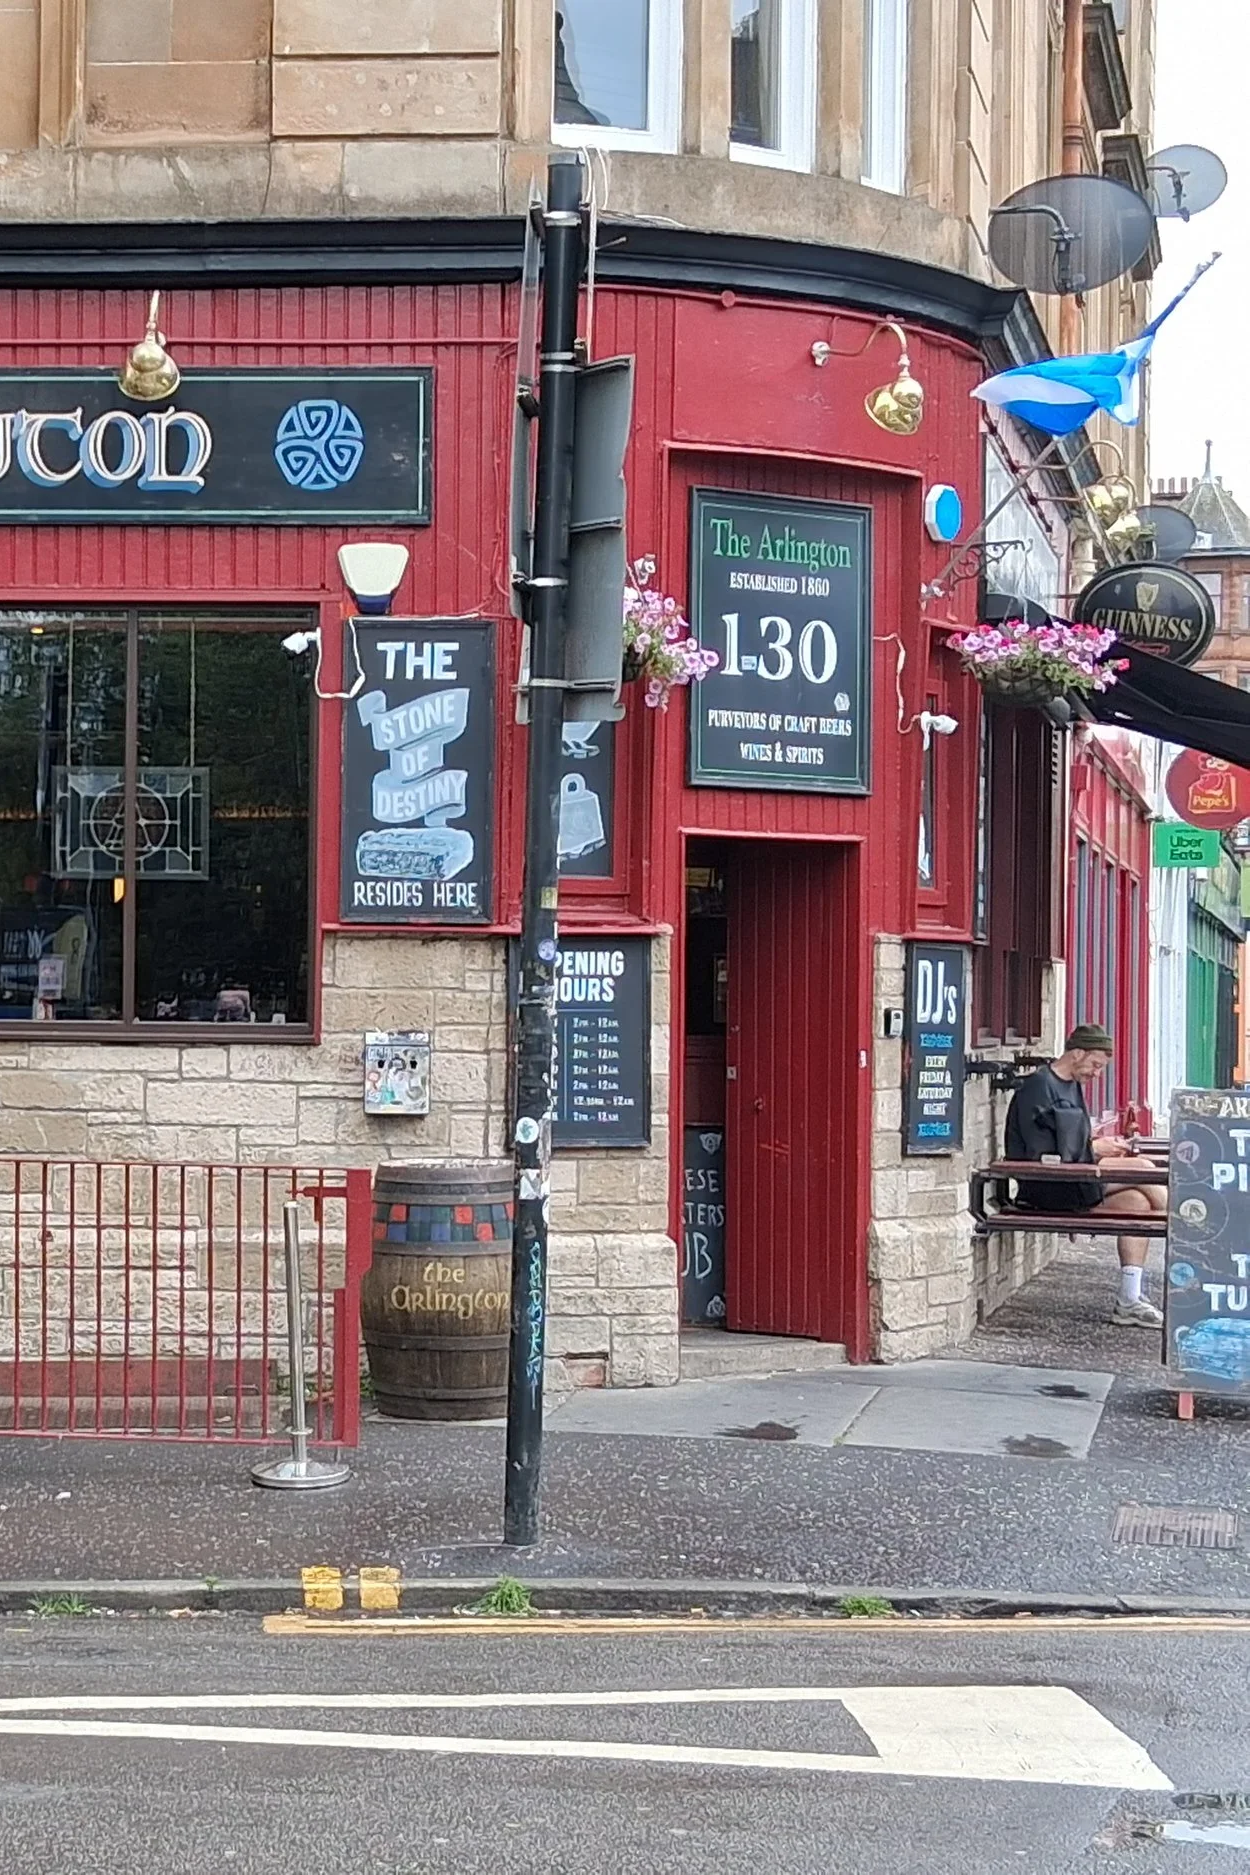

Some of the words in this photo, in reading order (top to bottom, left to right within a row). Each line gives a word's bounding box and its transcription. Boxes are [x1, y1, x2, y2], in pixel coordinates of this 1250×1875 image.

[710, 518, 751, 559] The
[757, 523, 852, 574] Arlington
[729, 571, 798, 595] ESTABLISHED
[801, 576, 831, 598] 1860
[1092, 607, 1193, 642] GUINNESS
[375, 641, 460, 680] THE
[379, 693, 456, 745] STONE
[708, 709, 767, 731] PURVEYORS
[768, 713, 782, 732] OF
[784, 714, 818, 734] CRAFT
[819, 717, 853, 737] BEERS
[401, 746, 431, 776] OF
[739, 741, 772, 762] WINES
[774, 741, 784, 763] &
[785, 745, 825, 765] SPIRITS
[377, 777, 465, 820] DESTINY
[1170, 835, 1204, 848] Uber
[1170, 849, 1204, 861] Eats
[353, 880, 423, 908] RESIDES
[433, 881, 478, 908] HERE
[554, 950, 625, 977] PENING
[683, 1168, 720, 1192] ESE
[681, 1202, 726, 1227] TERS
[423, 1262, 466, 1284] the
